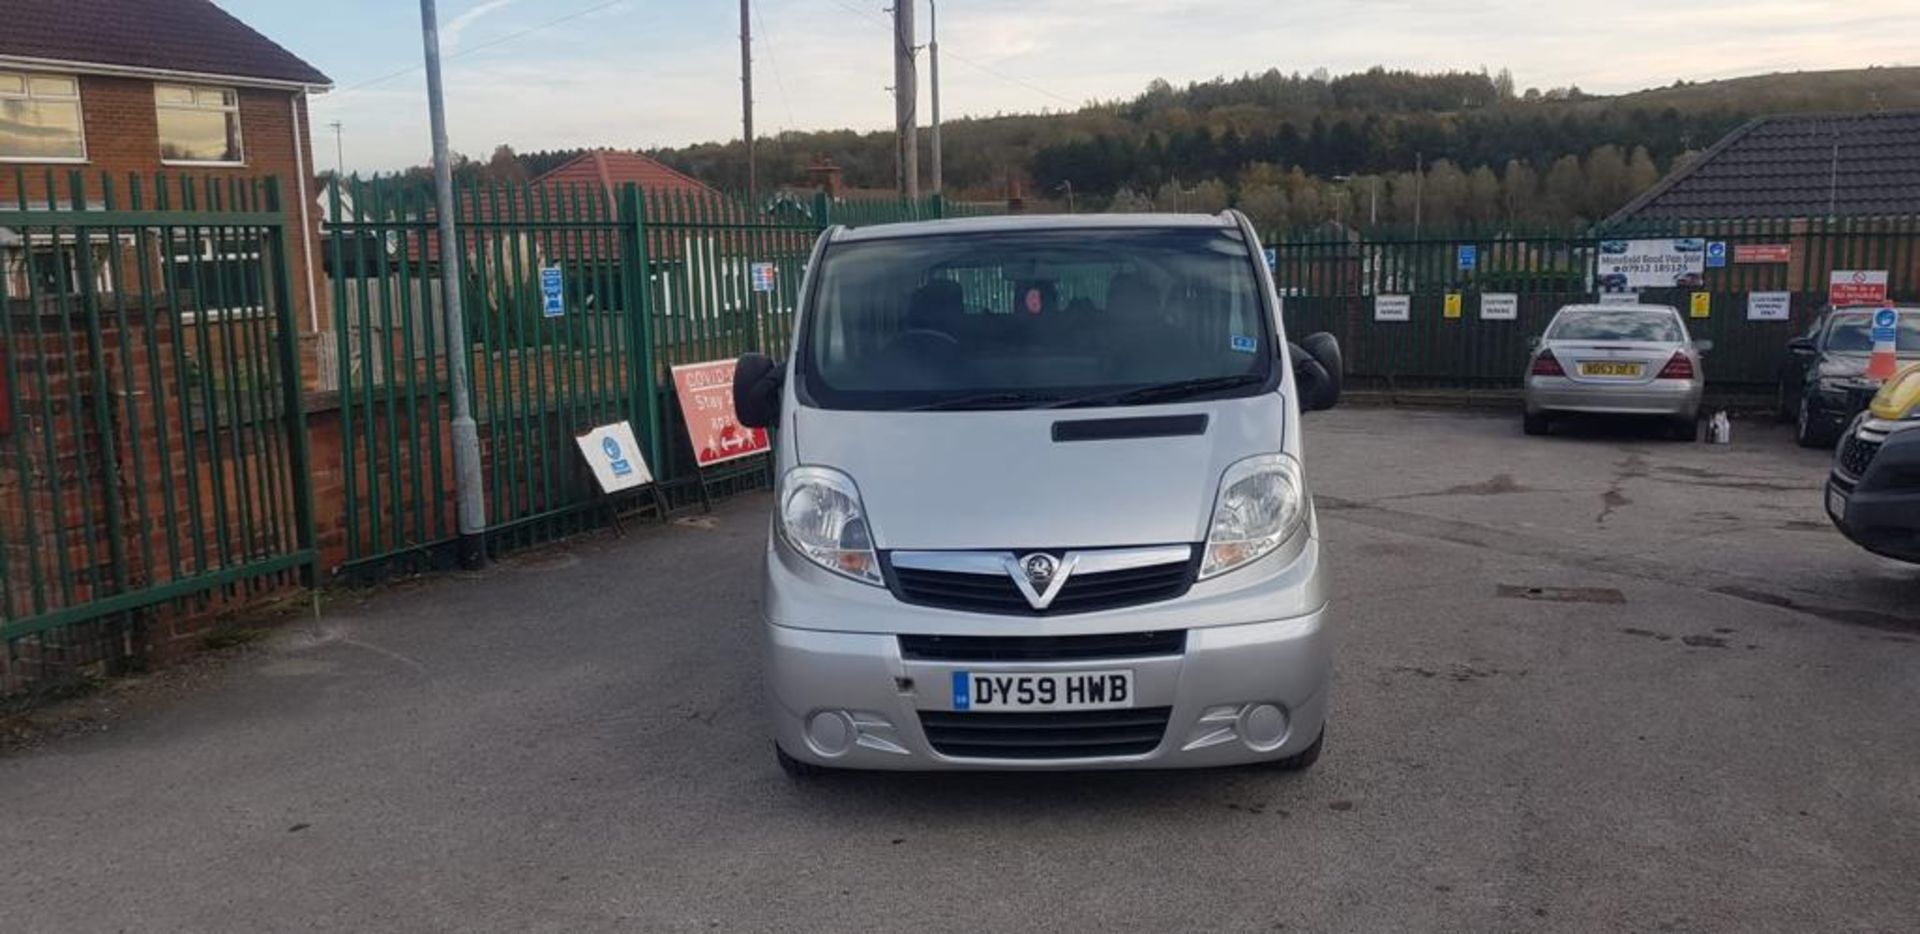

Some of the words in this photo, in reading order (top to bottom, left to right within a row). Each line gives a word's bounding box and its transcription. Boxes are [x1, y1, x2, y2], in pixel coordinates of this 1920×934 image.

[695, 394, 723, 411] Stay
[974, 676, 1056, 705] DY59
[1066, 675, 1128, 704] HWB
